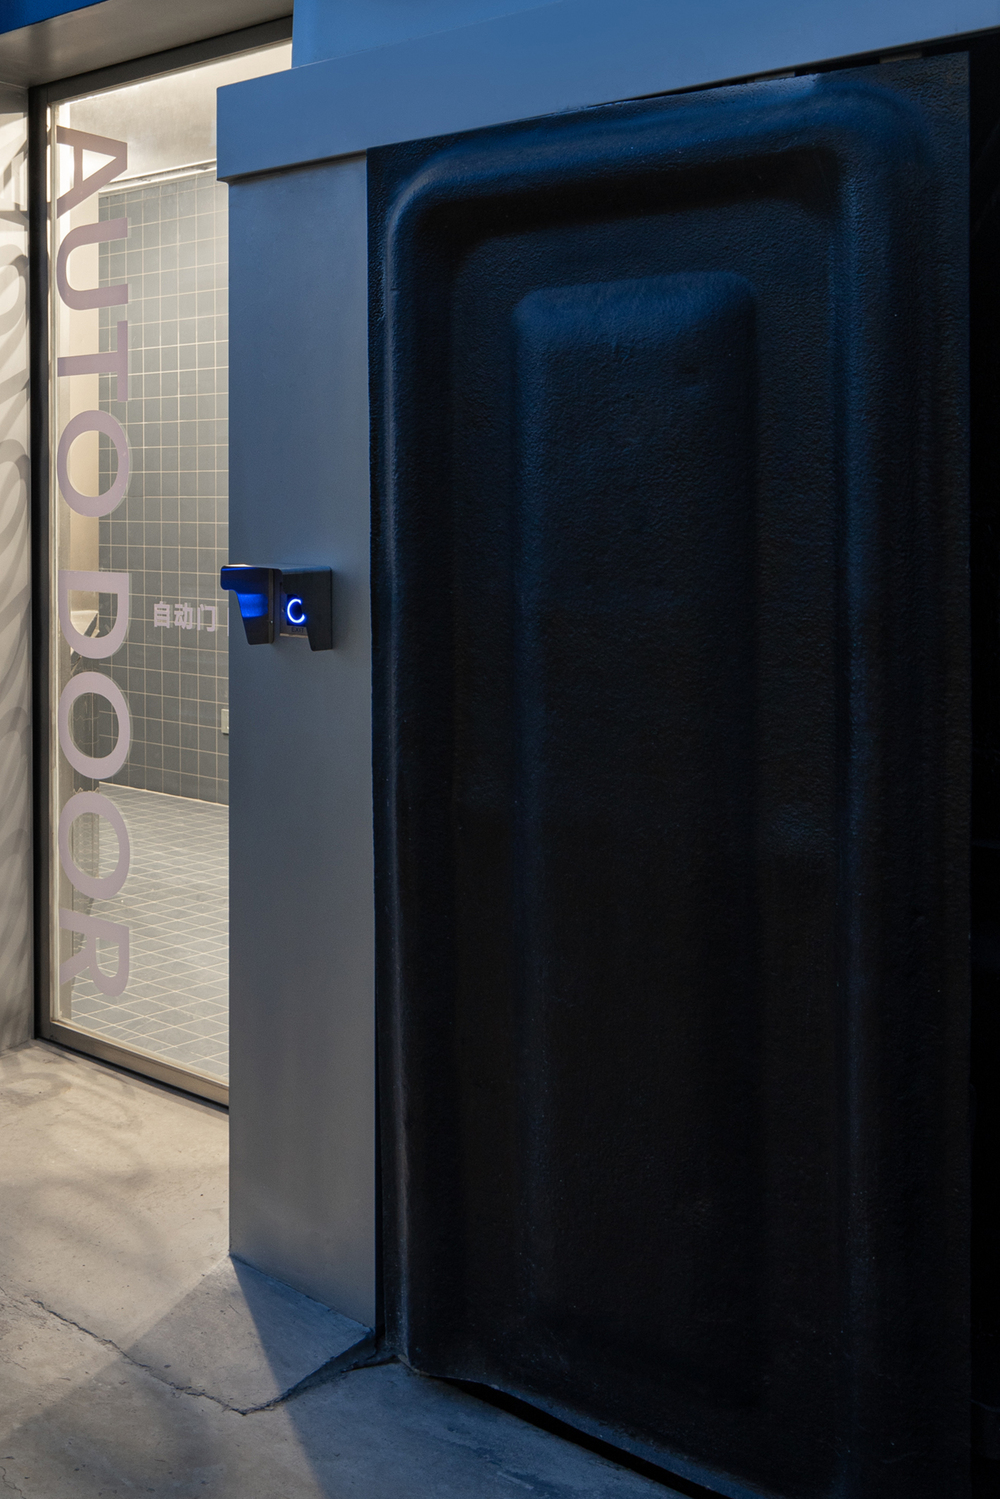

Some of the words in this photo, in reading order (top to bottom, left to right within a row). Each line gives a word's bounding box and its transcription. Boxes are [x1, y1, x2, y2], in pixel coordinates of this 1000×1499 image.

[56, 125, 130, 518] AUTO
[57, 569, 131, 997] DOOR
[153, 600, 216, 632] 自动门
